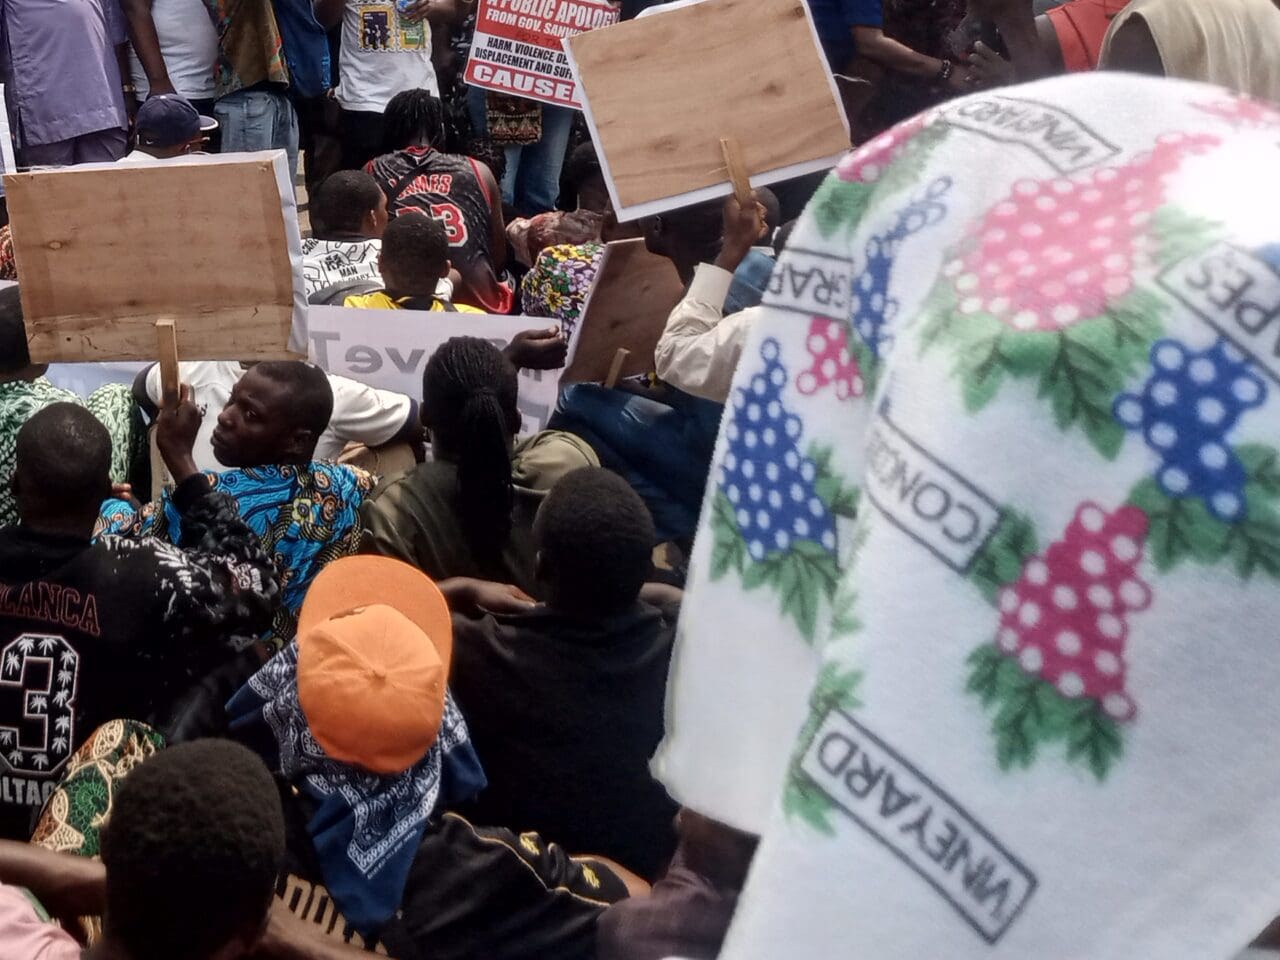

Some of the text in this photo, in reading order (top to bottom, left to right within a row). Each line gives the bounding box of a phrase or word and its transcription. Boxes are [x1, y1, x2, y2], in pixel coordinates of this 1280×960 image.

[486, 8, 516, 27] FROM
[517, 16, 541, 33] GOV.
[474, 47, 535, 71] DISPLACEMENT
[536, 58, 553, 75] AND
[473, 64, 583, 103] CAUSE
[818, 731, 1012, 920] VINEYARD
